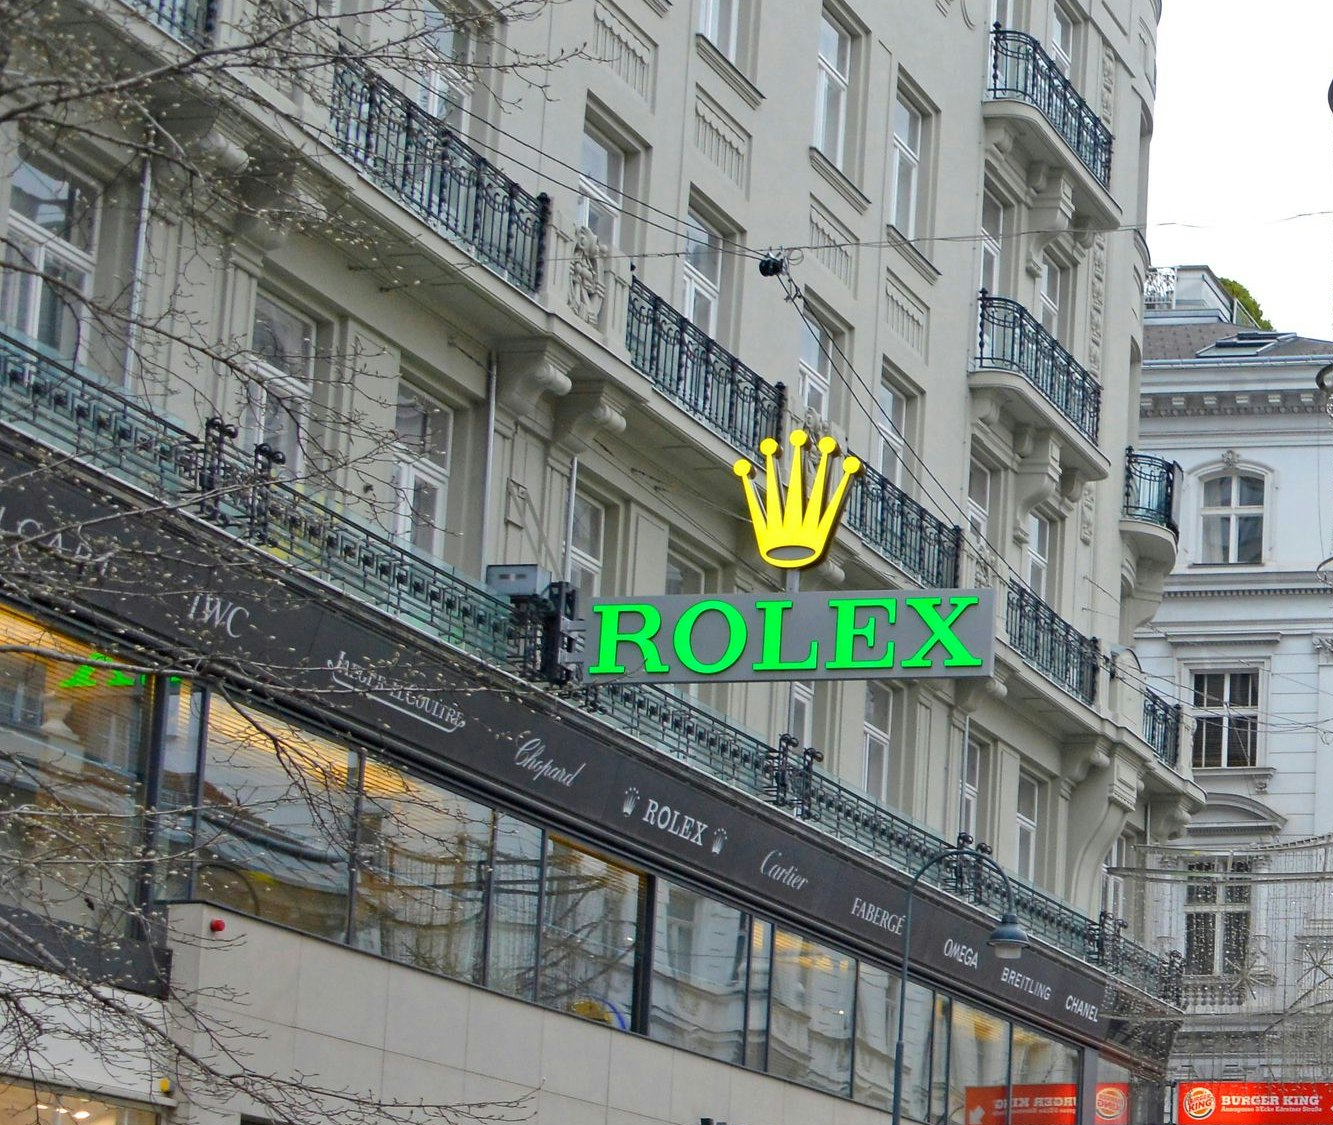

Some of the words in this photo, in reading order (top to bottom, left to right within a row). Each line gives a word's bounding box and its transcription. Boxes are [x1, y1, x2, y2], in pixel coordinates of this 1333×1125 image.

[188, 595, 250, 638] IWC
[588, 597, 983, 675] ROLEX
[514, 731, 586, 788] Chopard
[643, 798, 709, 847] ROLEX
[759, 849, 809, 890] Cartier
[851, 897, 907, 936] FABERGÉ
[943, 938, 978, 970] OMEGA
[1001, 967, 1052, 1001] BREITLING
[1065, 994, 1099, 1023] CHANEL
[1189, 1099, 1212, 1111] KING
[1221, 1096, 1280, 1106] BURGER
[1283, 1095, 1320, 1106] KING
